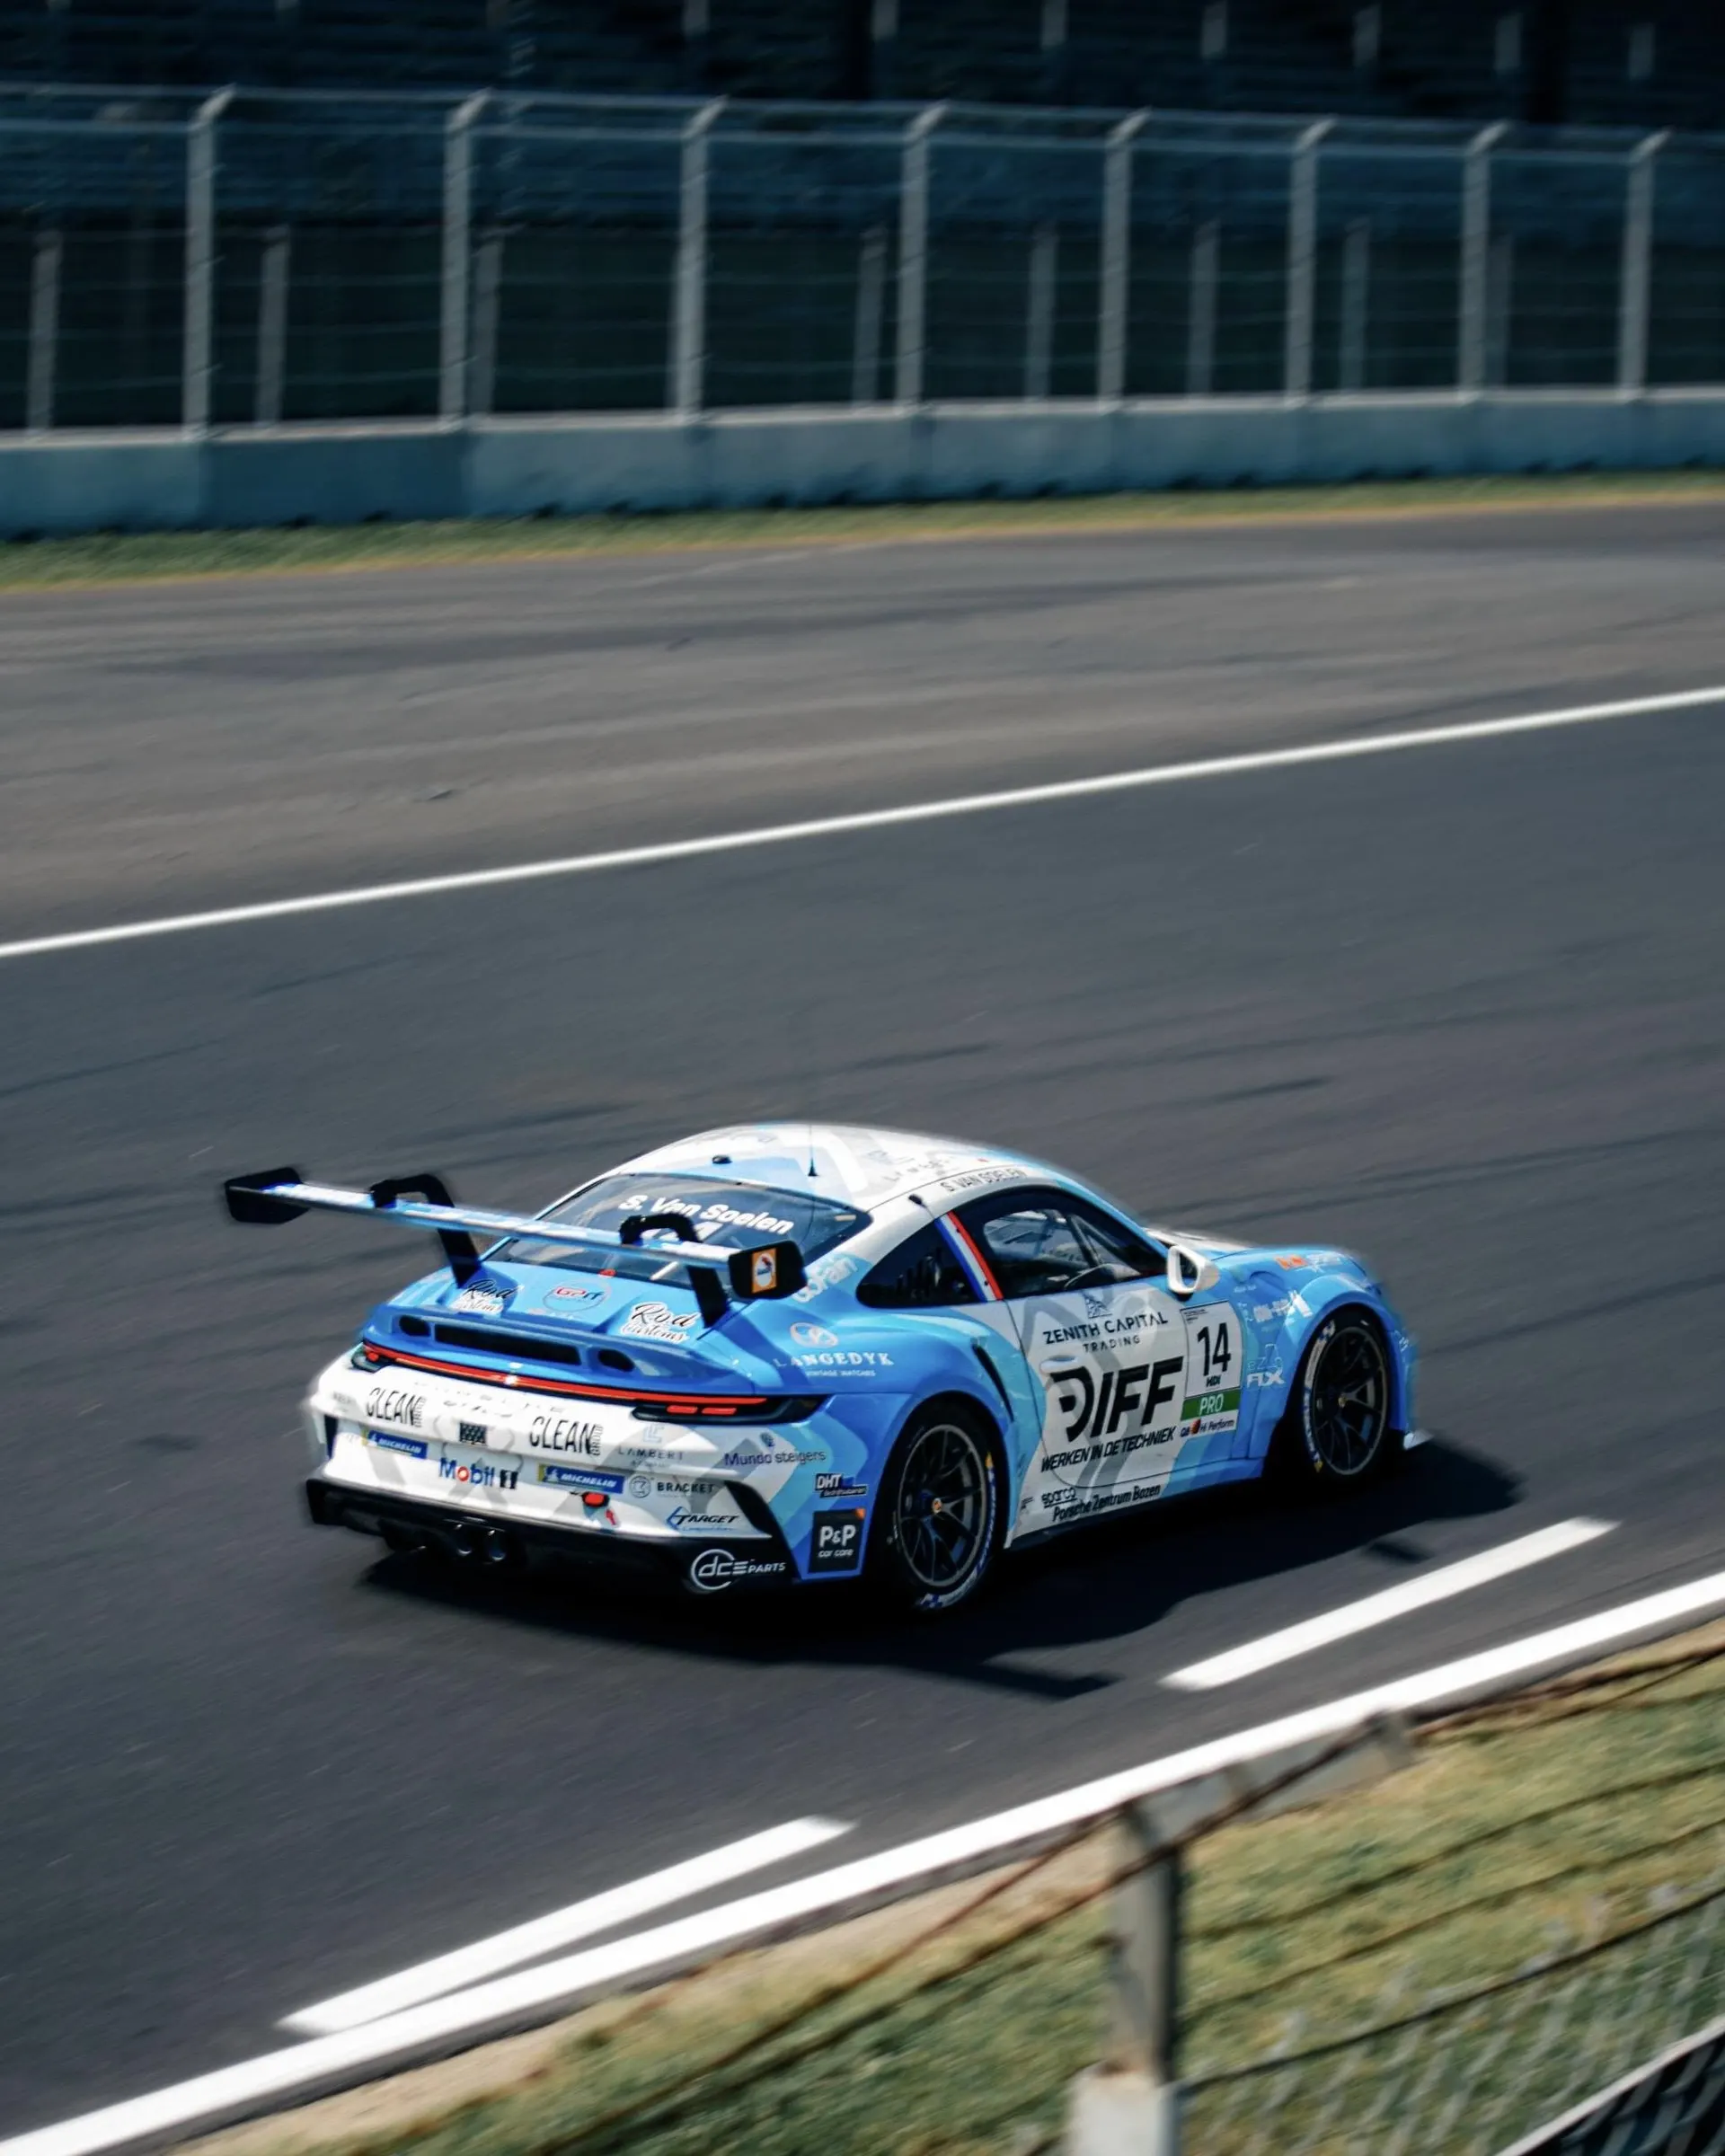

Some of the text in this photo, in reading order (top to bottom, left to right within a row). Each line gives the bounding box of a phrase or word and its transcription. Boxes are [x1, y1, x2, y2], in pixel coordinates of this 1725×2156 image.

[618, 1195, 648, 1211] S.
[650, 1197, 702, 1216] Van
[701, 1204, 794, 1234] Soelen
[632, 1303, 696, 1327] Rod
[1043, 1323, 1101, 1345] ZENITH
[1104, 1311, 1168, 1333] CAPITAL
[1083, 1335, 1140, 1352] TRADING
[1197, 1322, 1232, 1376] 14
[367, 1387, 422, 1427] CLEAN
[1199, 1393, 1225, 1416] PRO
[377, 1437, 422, 1454] MICHELIN
[529, 1416, 597, 1454] CLEAN
[724, 1450, 826, 1466] Mundo steigers
[1040, 1426, 1177, 1472] WERKEN IN DE TECHNIEK
[439, 1457, 496, 1488] Mobil
[560, 1471, 618, 1489] MICHELIN
[817, 1475, 841, 1489] DHT
[657, 1481, 715, 1493] BRACKET
[1041, 1487, 1077, 1506] sparco
[1052, 1498, 1092, 1522] Porsche
[1092, 1489, 1132, 1511] Zentrum
[1131, 1484, 1162, 1501] Bozen
[676, 1515, 739, 1525] TARGET
[819, 1524, 856, 1548] P&P
[818, 1548, 854, 1559] car care
[748, 1561, 787, 1573] PARTS
